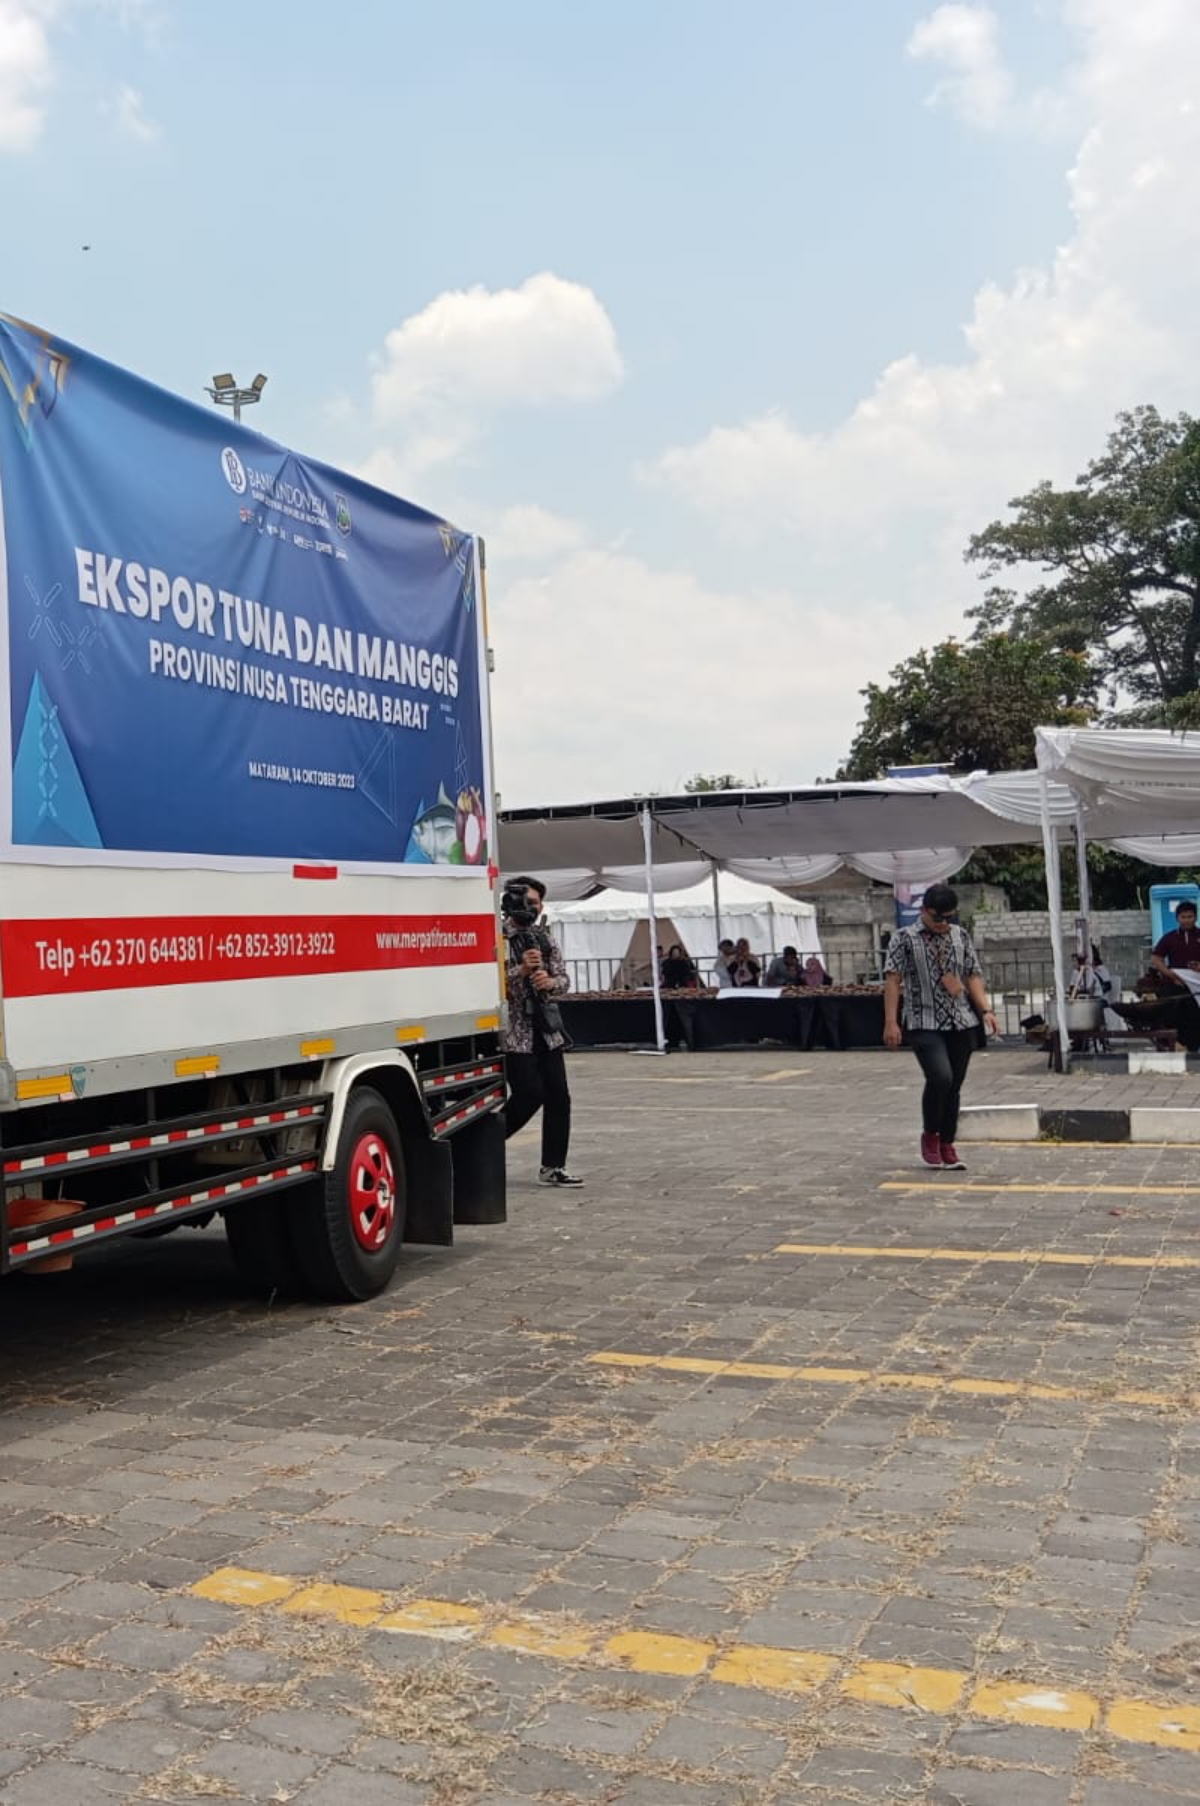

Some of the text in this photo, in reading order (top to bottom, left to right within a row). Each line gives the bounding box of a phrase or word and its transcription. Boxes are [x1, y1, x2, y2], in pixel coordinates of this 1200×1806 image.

[75, 546, 459, 698] EKSPOR TUNA DAN MANGGIS
[150, 638, 429, 730] PROVINSI NUSA TENGGARA BARAT
[248, 761, 292, 784] MATARAM,
[302, 769, 336, 787] OKTOBER
[36, 939, 75, 976] Telp
[79, 940, 112, 968] +62
[116, 938, 145, 965] 370
[150, 935, 204, 963] 644381
[216, 933, 243, 959] +62
[245, 932, 336, 958] 852-3912-3922
[376, 920, 478, 954] www.merpatitrans.com
